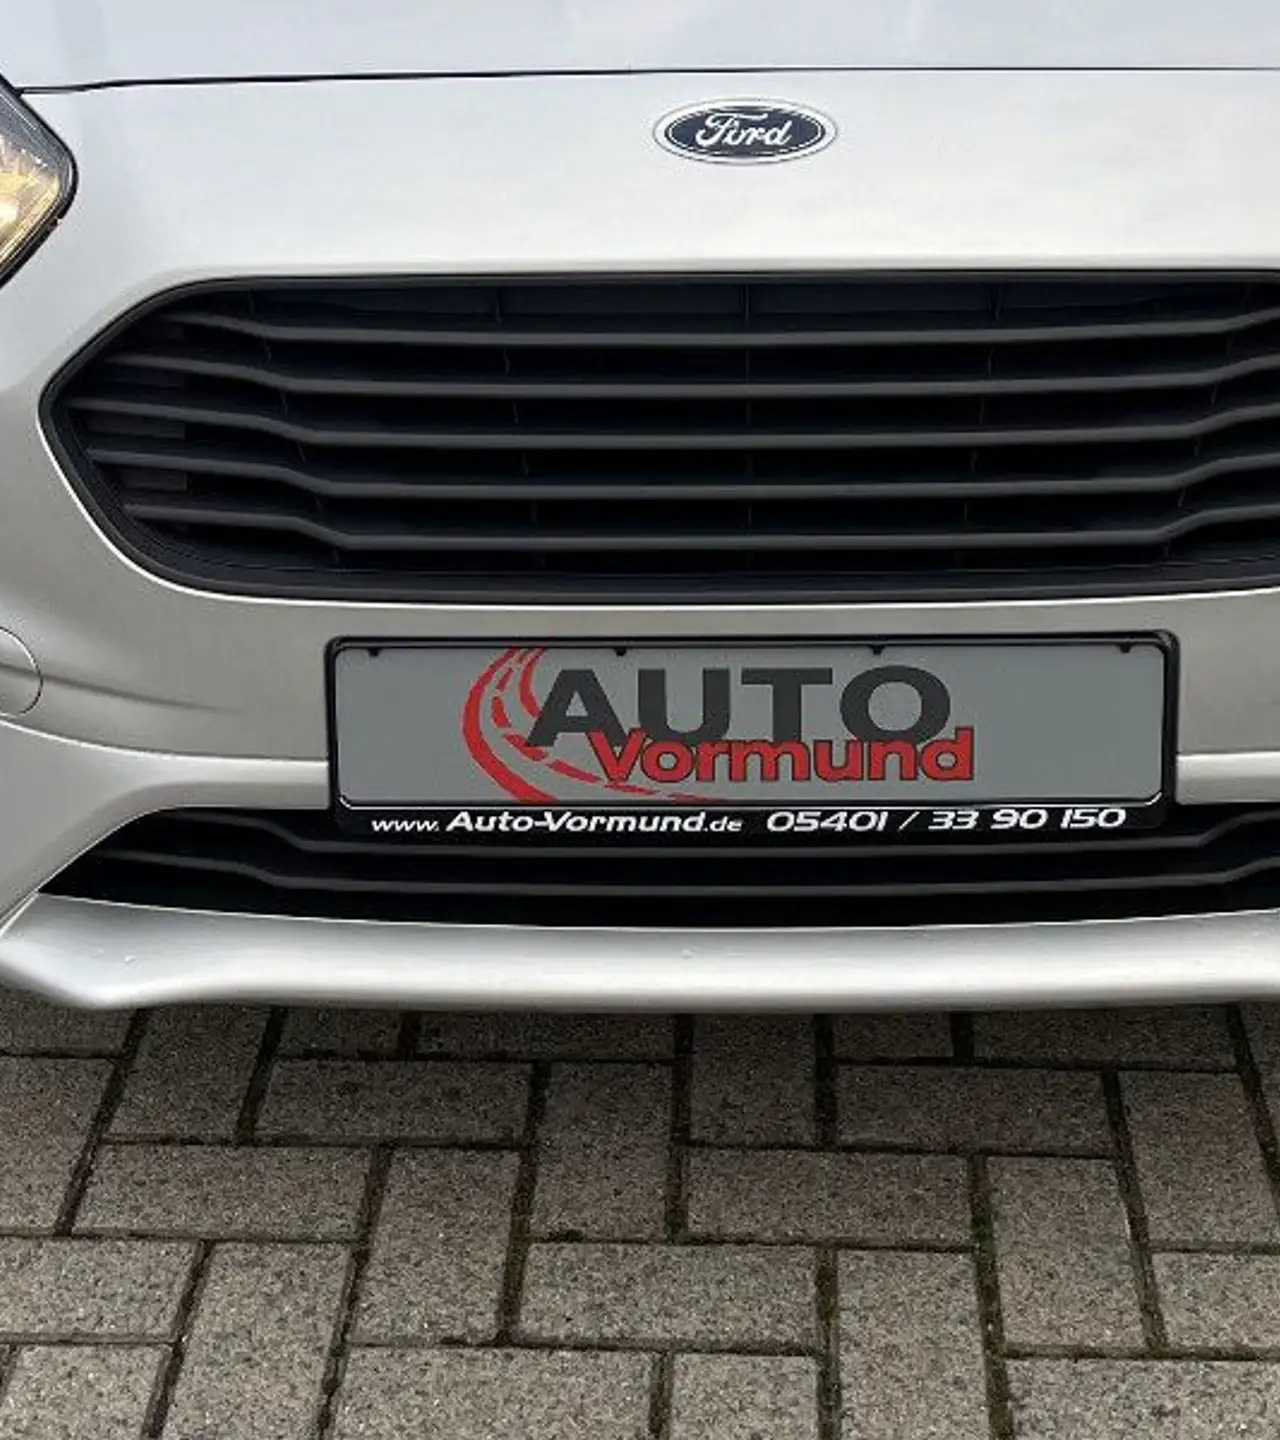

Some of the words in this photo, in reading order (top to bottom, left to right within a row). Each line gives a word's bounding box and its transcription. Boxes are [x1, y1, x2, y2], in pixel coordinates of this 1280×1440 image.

[694, 112, 793, 147] Ford
[526, 665, 951, 747] AUTO
[586, 725, 975, 783] Vormund
[766, 810, 888, 832] 05401
[928, 809, 979, 831] 33
[990, 808, 1048, 830] 90
[1060, 808, 1127, 830] 150
